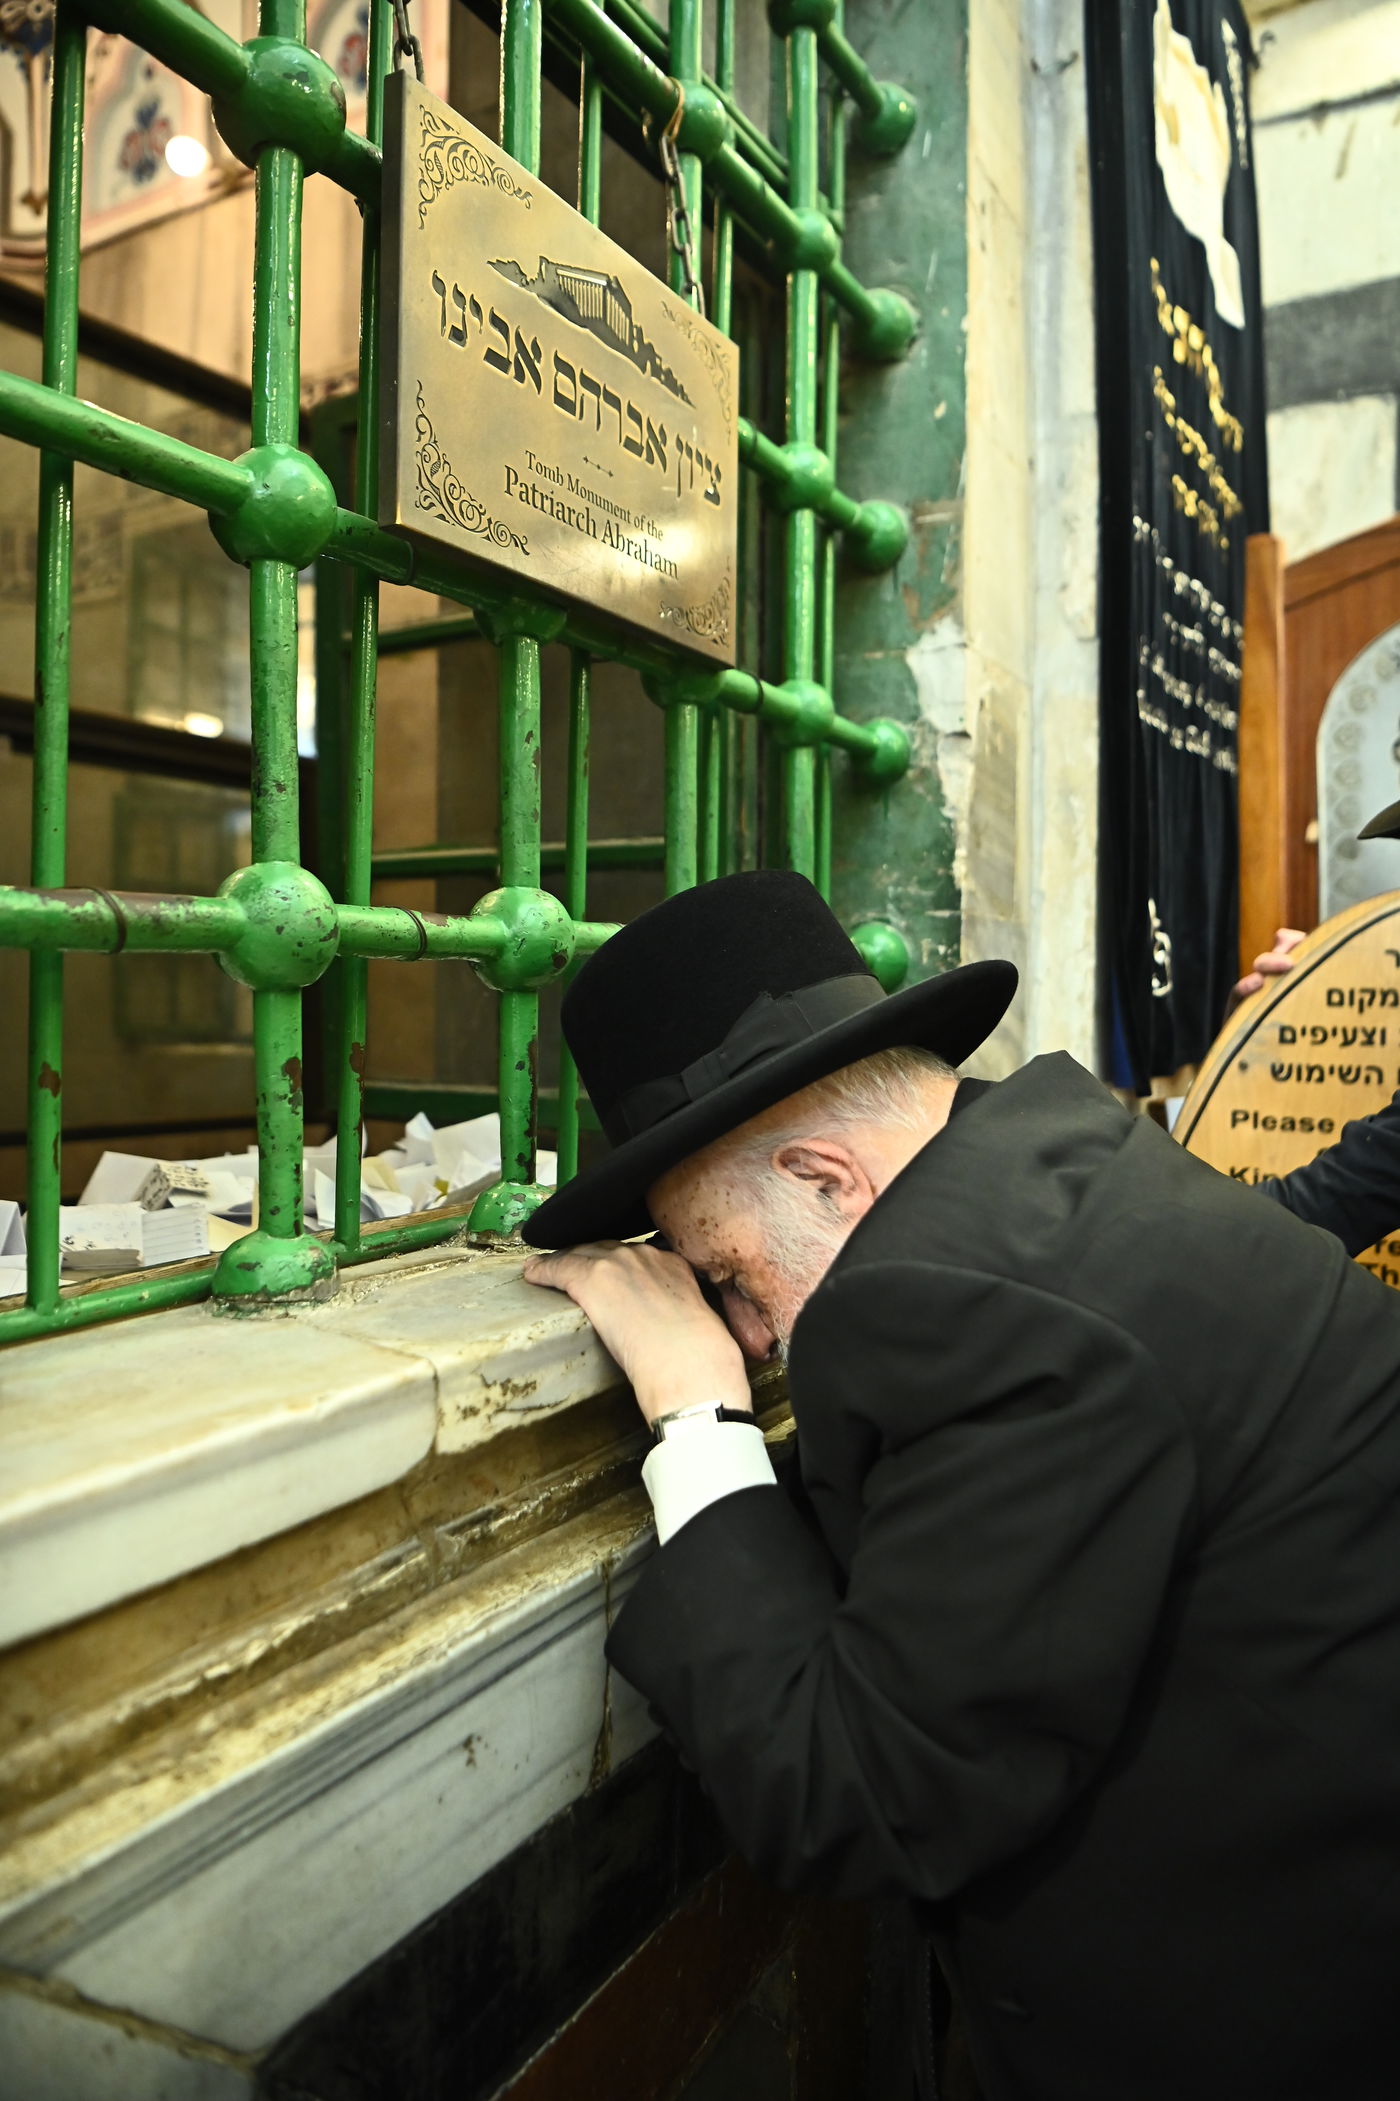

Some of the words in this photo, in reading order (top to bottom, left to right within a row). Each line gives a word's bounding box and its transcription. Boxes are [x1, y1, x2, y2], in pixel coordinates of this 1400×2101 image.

[431, 269, 542, 396] אבינו
[553, 349, 668, 474] אברהם
[525, 450, 564, 486] Tomb
[567, 473, 631, 524] Monument
[634, 513, 647, 532] of
[647, 519, 664, 542] the
[674, 433, 722, 507] ציון
[504, 464, 598, 540] Patriarch
[601, 519, 679, 581] Abraham
[1270, 1062, 1384, 1086] השימוש
[1278, 1024, 1387, 1048] וצעיפים
[1230, 1109, 1335, 1134] Please
